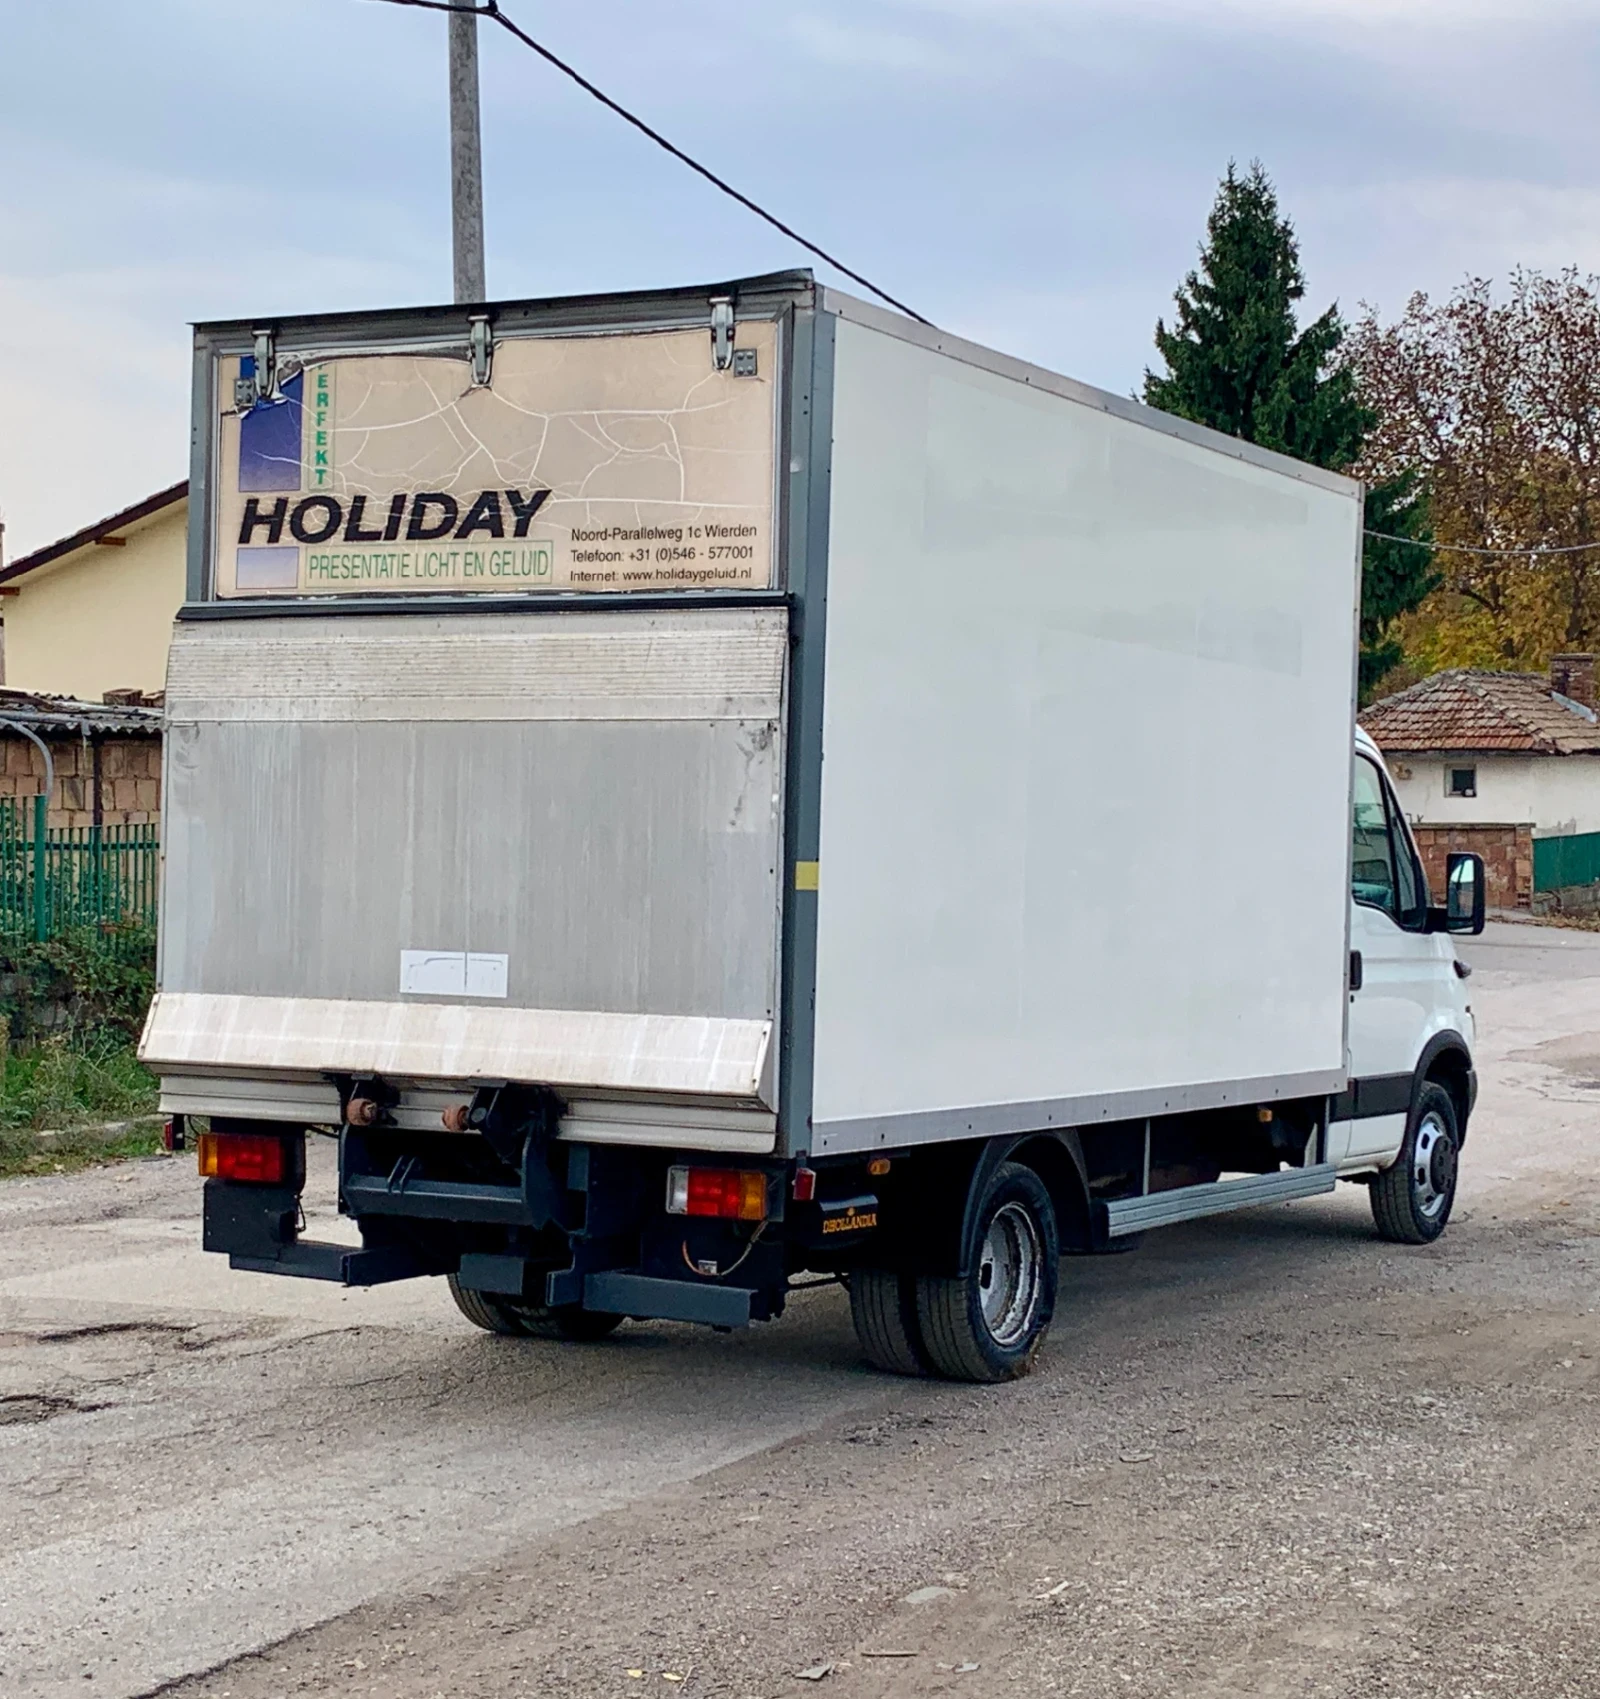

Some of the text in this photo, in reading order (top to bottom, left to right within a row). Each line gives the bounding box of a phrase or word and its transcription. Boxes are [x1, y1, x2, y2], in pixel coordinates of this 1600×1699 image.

[314, 364, 329, 485] ERFEKT
[237, 489, 552, 544] HOLIDAY
[571, 524, 757, 542] Noord-Parallelweg 1c Wierden
[308, 549, 549, 580] PRESENTATIE LICHT EN GELUID
[570, 549, 624, 563] Telefoon:
[629, 548, 651, 561] +31
[655, 547, 696, 563] (0)546
[708, 545, 753, 560] 577001
[570, 567, 752, 583] Internet: www.holidaygeluid.nl
